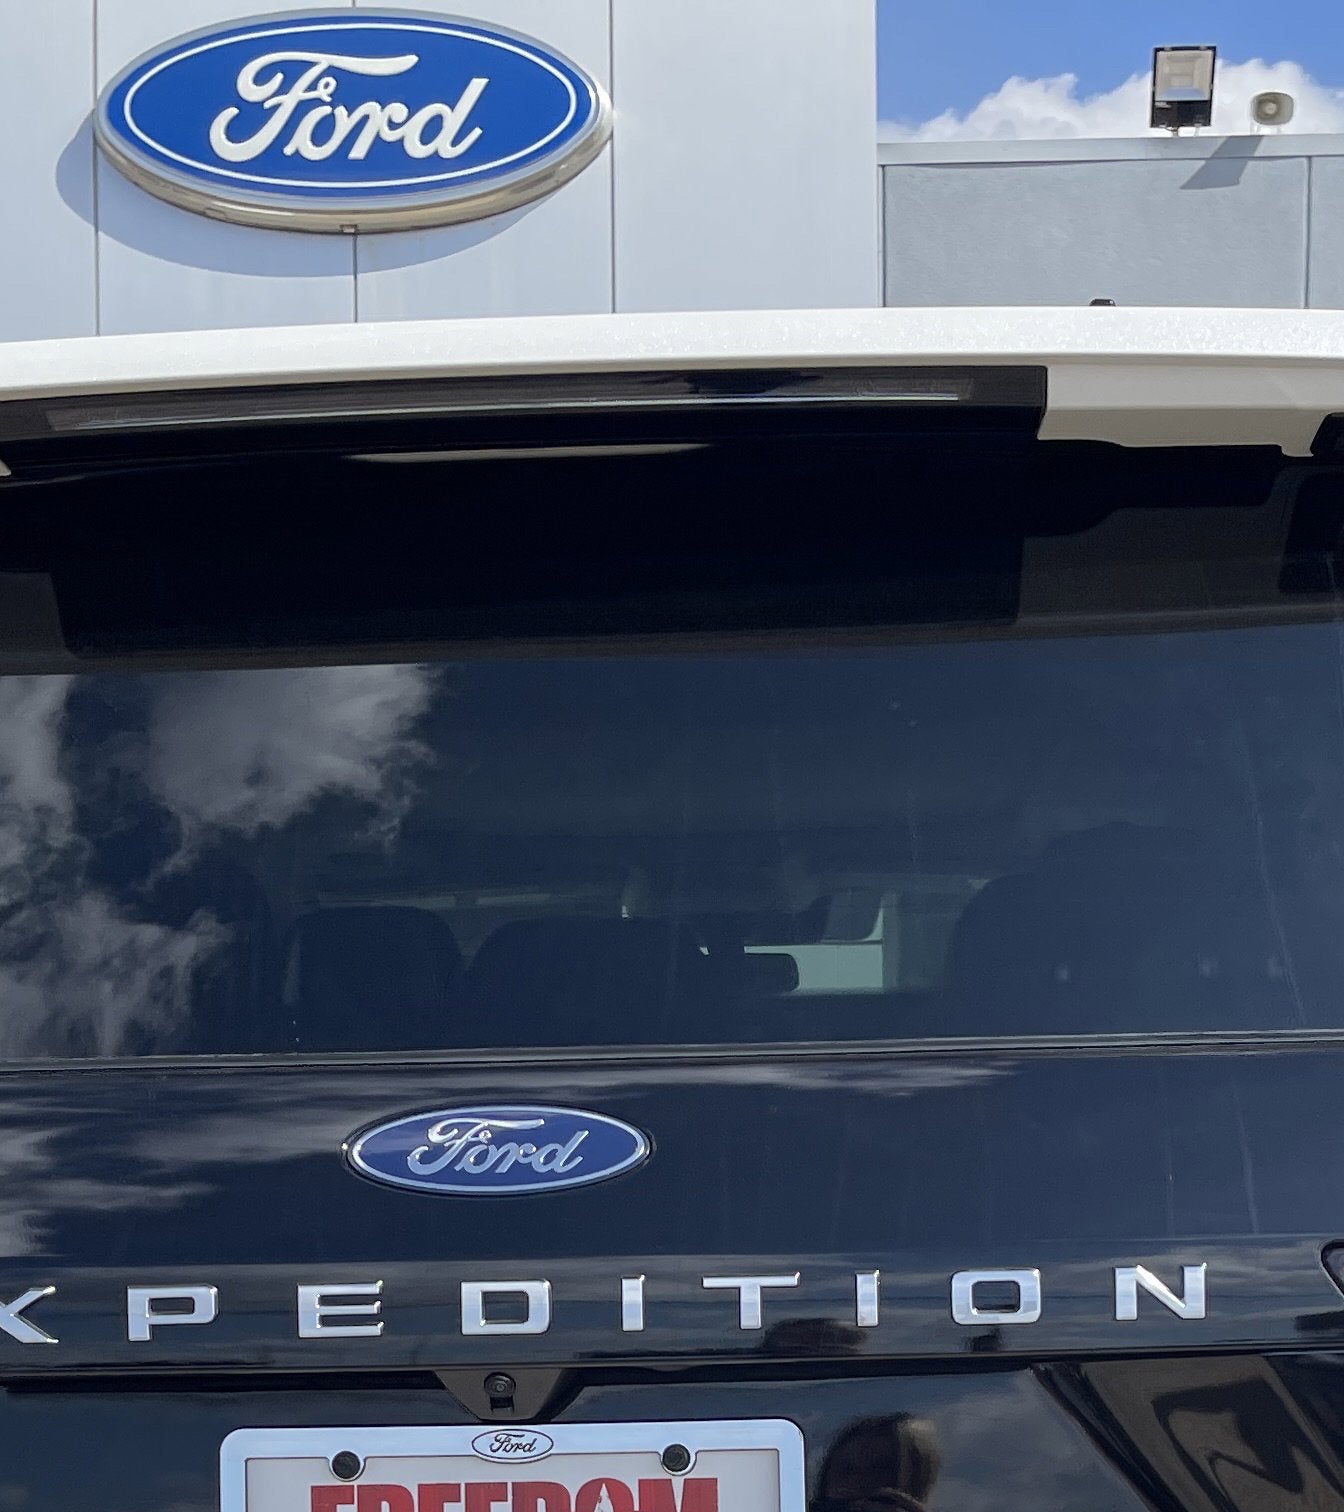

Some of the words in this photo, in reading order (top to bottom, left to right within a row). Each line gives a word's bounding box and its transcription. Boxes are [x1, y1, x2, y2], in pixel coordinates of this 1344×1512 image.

[209, 51, 489, 163] Ford
[406, 1117, 589, 1176] Ford
[489, 1432, 538, 1453] Ford
